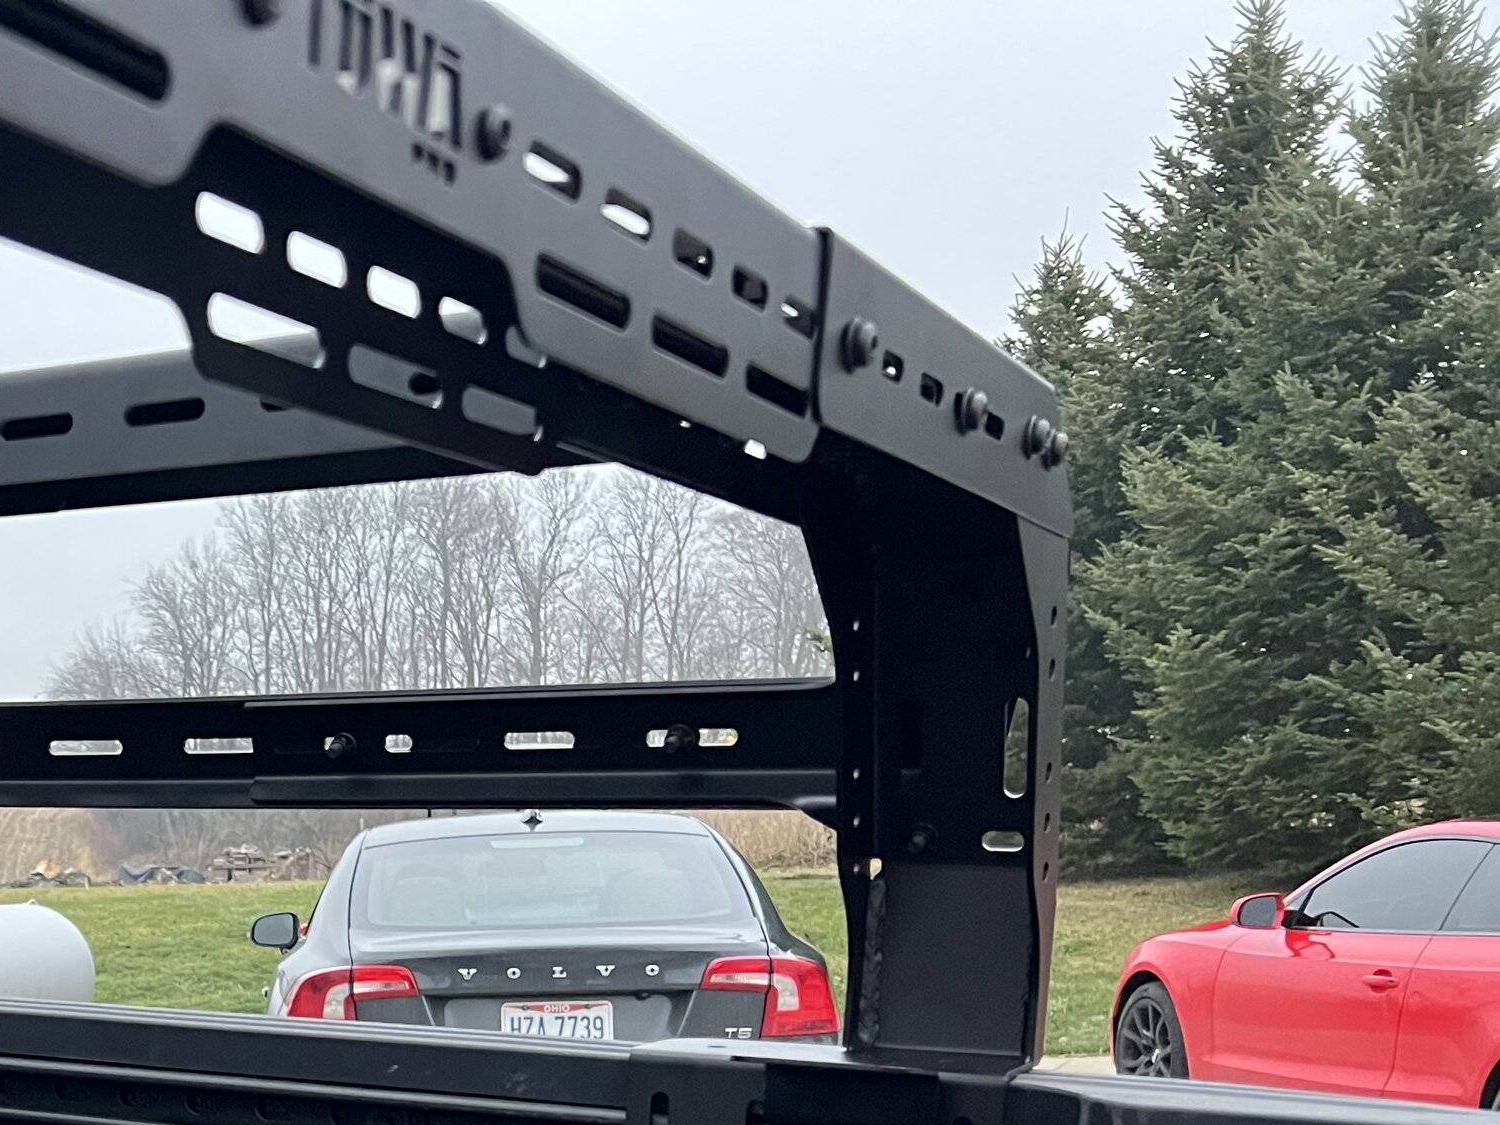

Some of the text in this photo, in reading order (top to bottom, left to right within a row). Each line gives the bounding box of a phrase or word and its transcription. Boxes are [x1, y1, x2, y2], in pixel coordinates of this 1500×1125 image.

[457, 963, 660, 981] VOLVO
[543, 1004, 570, 1013] OHIO
[554, 1016, 604, 1040] 7739
[724, 1027, 753, 1040] T5
